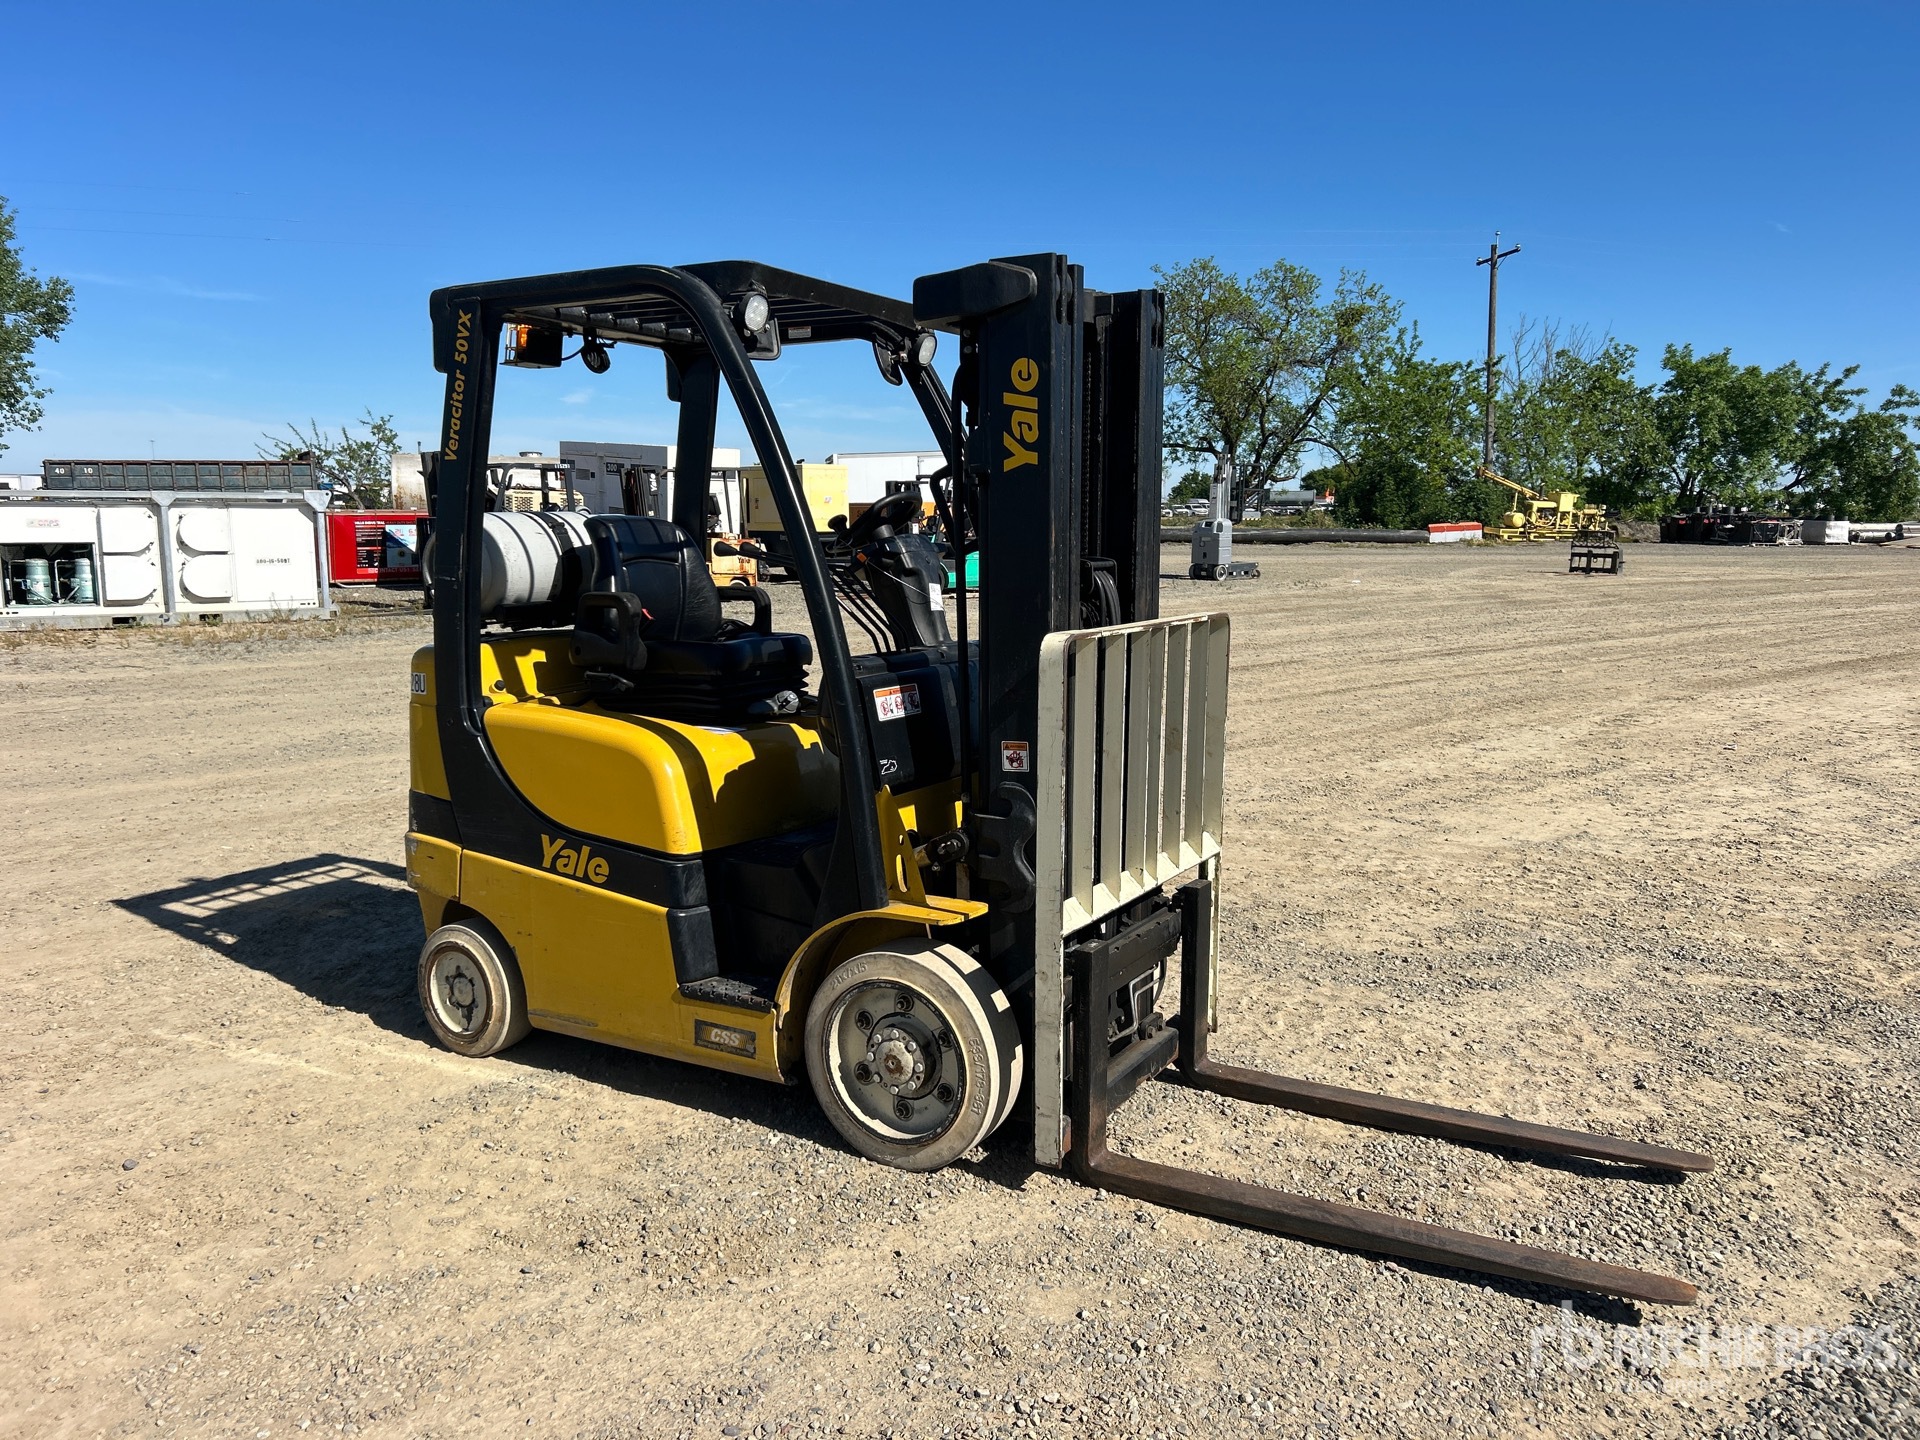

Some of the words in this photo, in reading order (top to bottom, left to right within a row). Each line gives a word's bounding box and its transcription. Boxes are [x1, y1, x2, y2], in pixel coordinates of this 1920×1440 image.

[454, 308, 473, 365] 50VX
[444, 369, 466, 461] Veracitor
[1003, 357, 1039, 473] Yale
[541, 834, 609, 884] Yale
[711, 1028, 740, 1047] CSS
